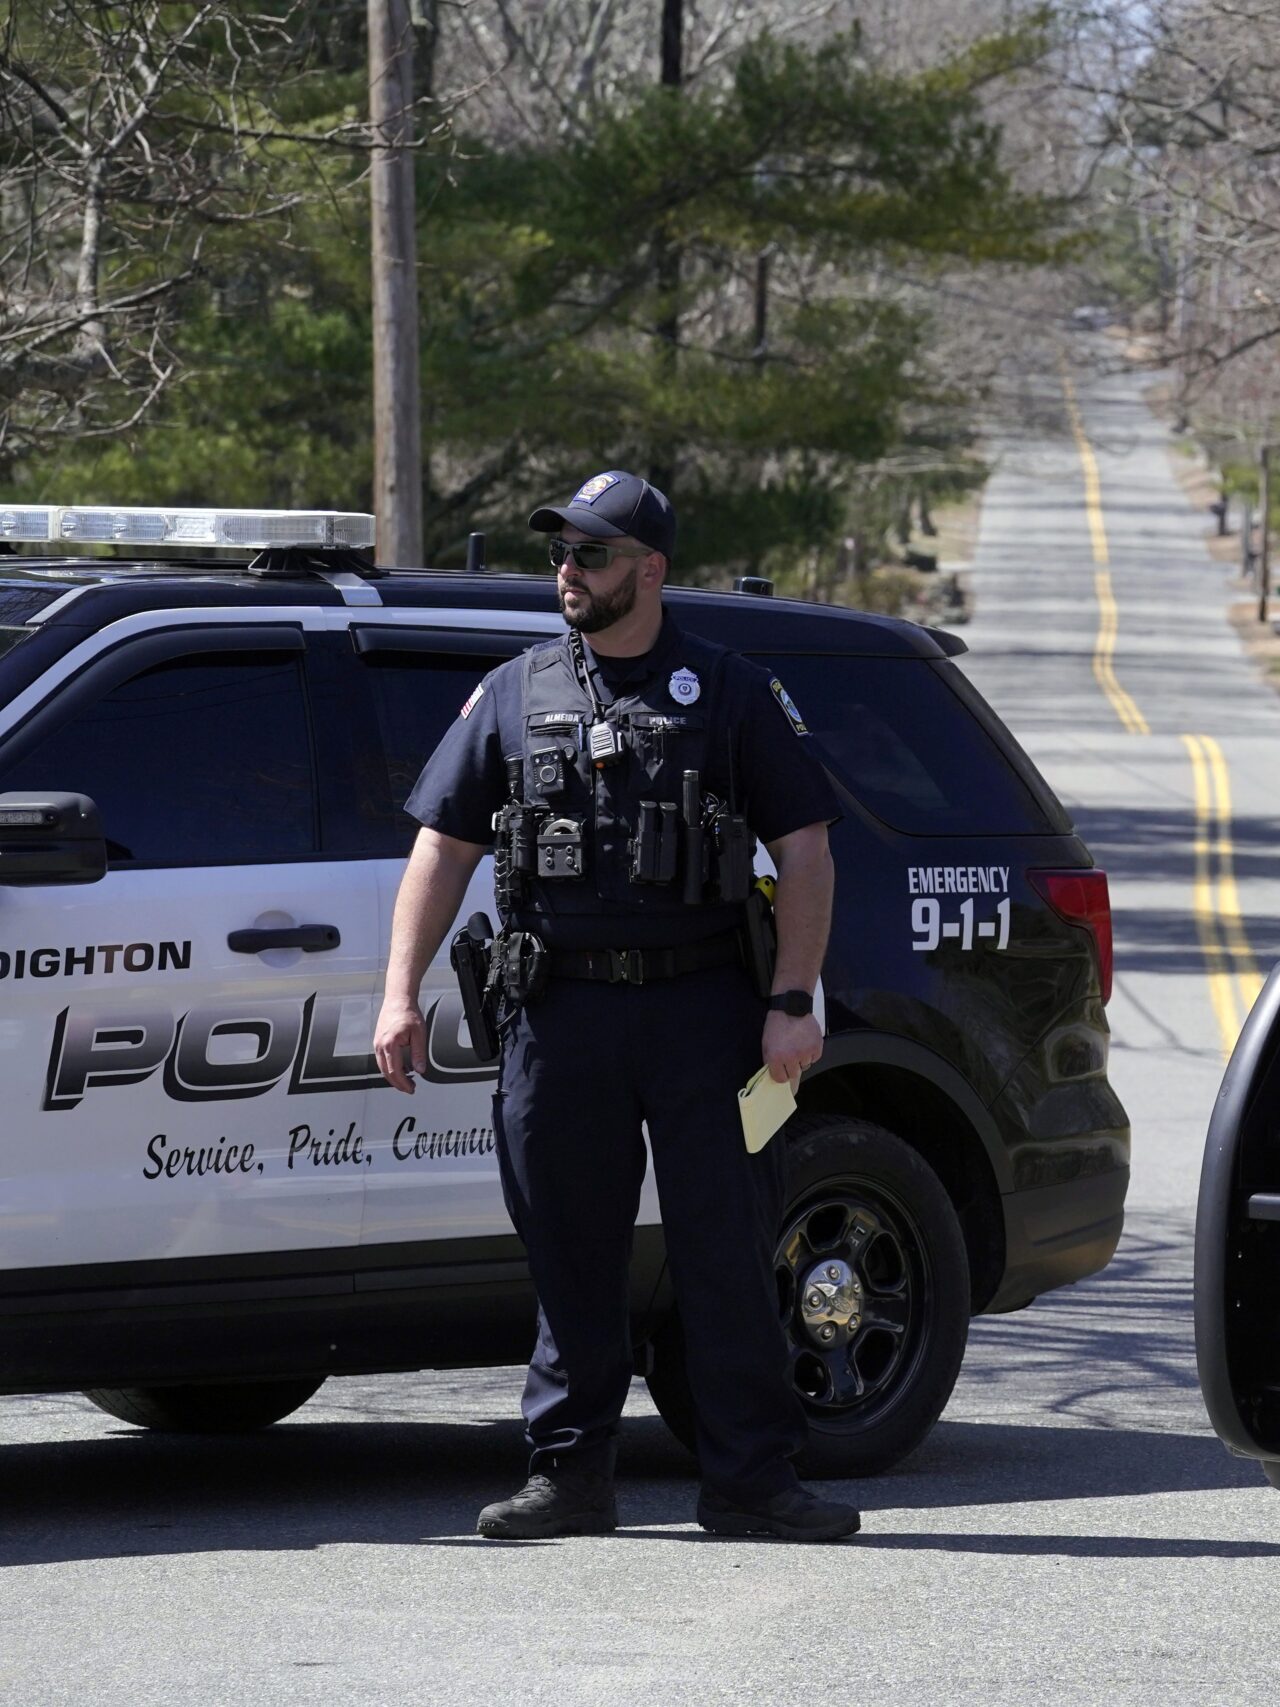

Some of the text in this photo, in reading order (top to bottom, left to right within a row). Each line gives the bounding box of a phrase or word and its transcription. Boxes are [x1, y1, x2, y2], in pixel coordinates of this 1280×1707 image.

[544, 713, 579, 723] ALMEIDA
[648, 716, 687, 725] POLICE
[907, 866, 1010, 894] EMERGENCY
[911, 897, 1011, 951] 9-1-1
[143, 1134, 264, 1179] Service,
[288, 1121, 372, 1169] Pride,
